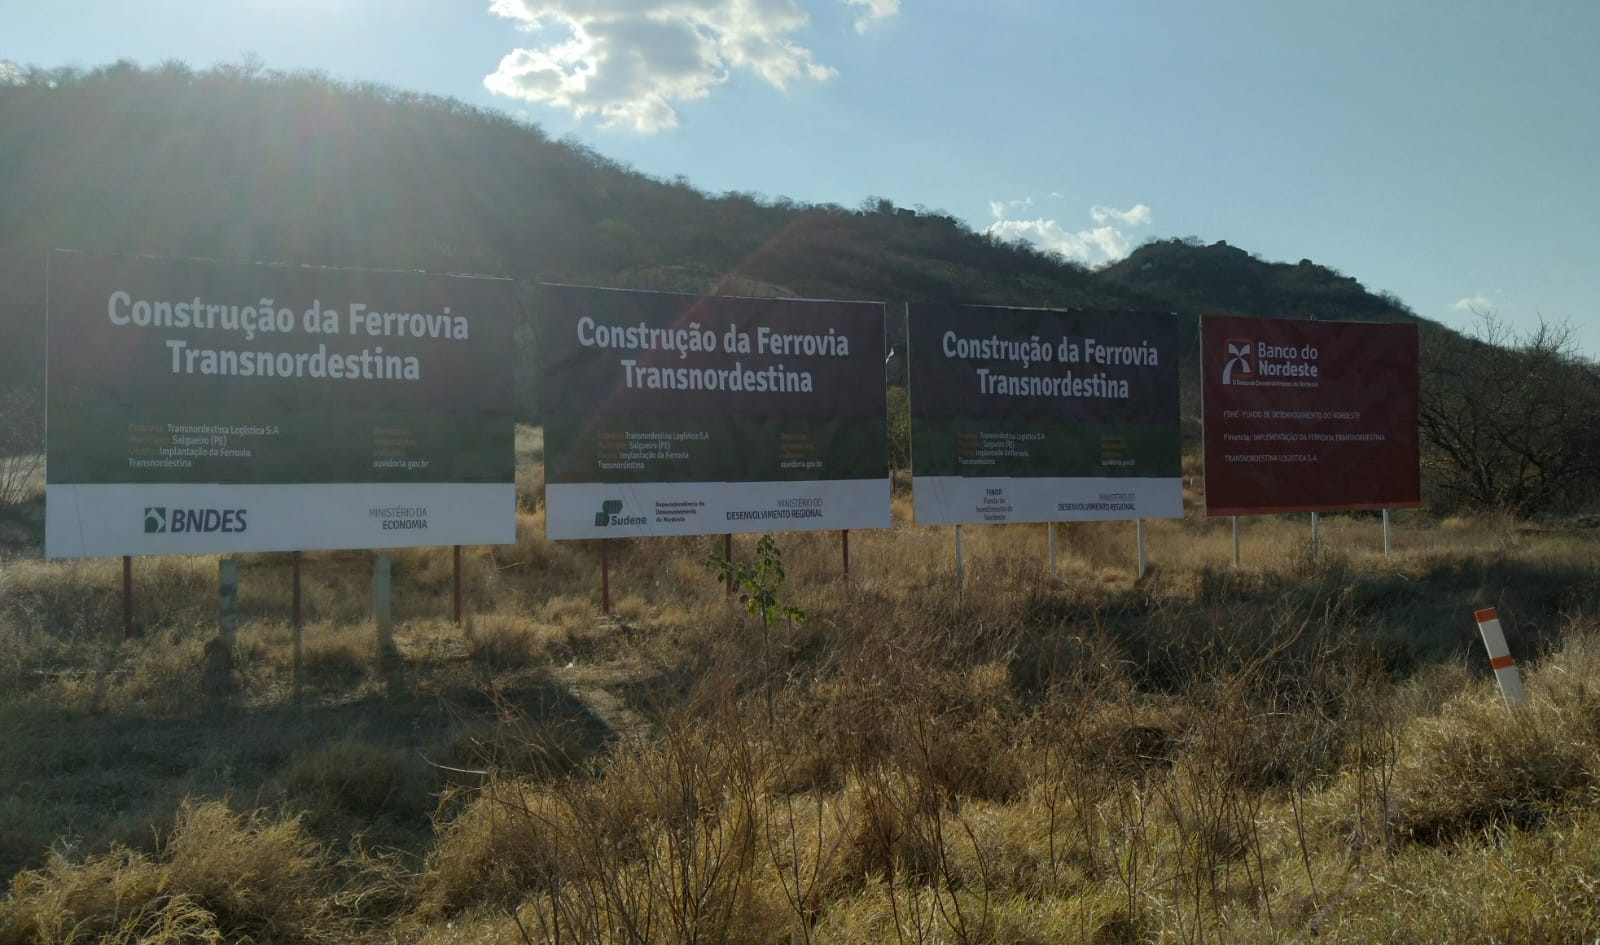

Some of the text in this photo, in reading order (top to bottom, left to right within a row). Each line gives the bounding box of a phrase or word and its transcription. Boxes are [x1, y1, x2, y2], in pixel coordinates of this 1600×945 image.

[108, 290, 469, 340] Construção da Ferrovia
[577, 316, 849, 359] Construção da Ferrovia
[942, 330, 1159, 368] Construção da Ferrovia
[1258, 342, 1318, 360] Banco do
[166, 340, 420, 380] Transnordestina
[1258, 360, 1318, 377] Nordeste
[620, 360, 814, 392] Transnordestina
[976, 368, 1129, 398] Transnordestina
[168, 424, 229, 434] Transnordestina
[220, 448, 250, 456] Ferrovia
[171, 509, 247, 533] BNDES
[369, 506, 428, 518] MINISTÉRIO DA
[612, 515, 647, 526] Sudene
[726, 508, 823, 521] DESENVOLVIMENTO REGIONAL
[382, 518, 428, 530] ECONOMIA
